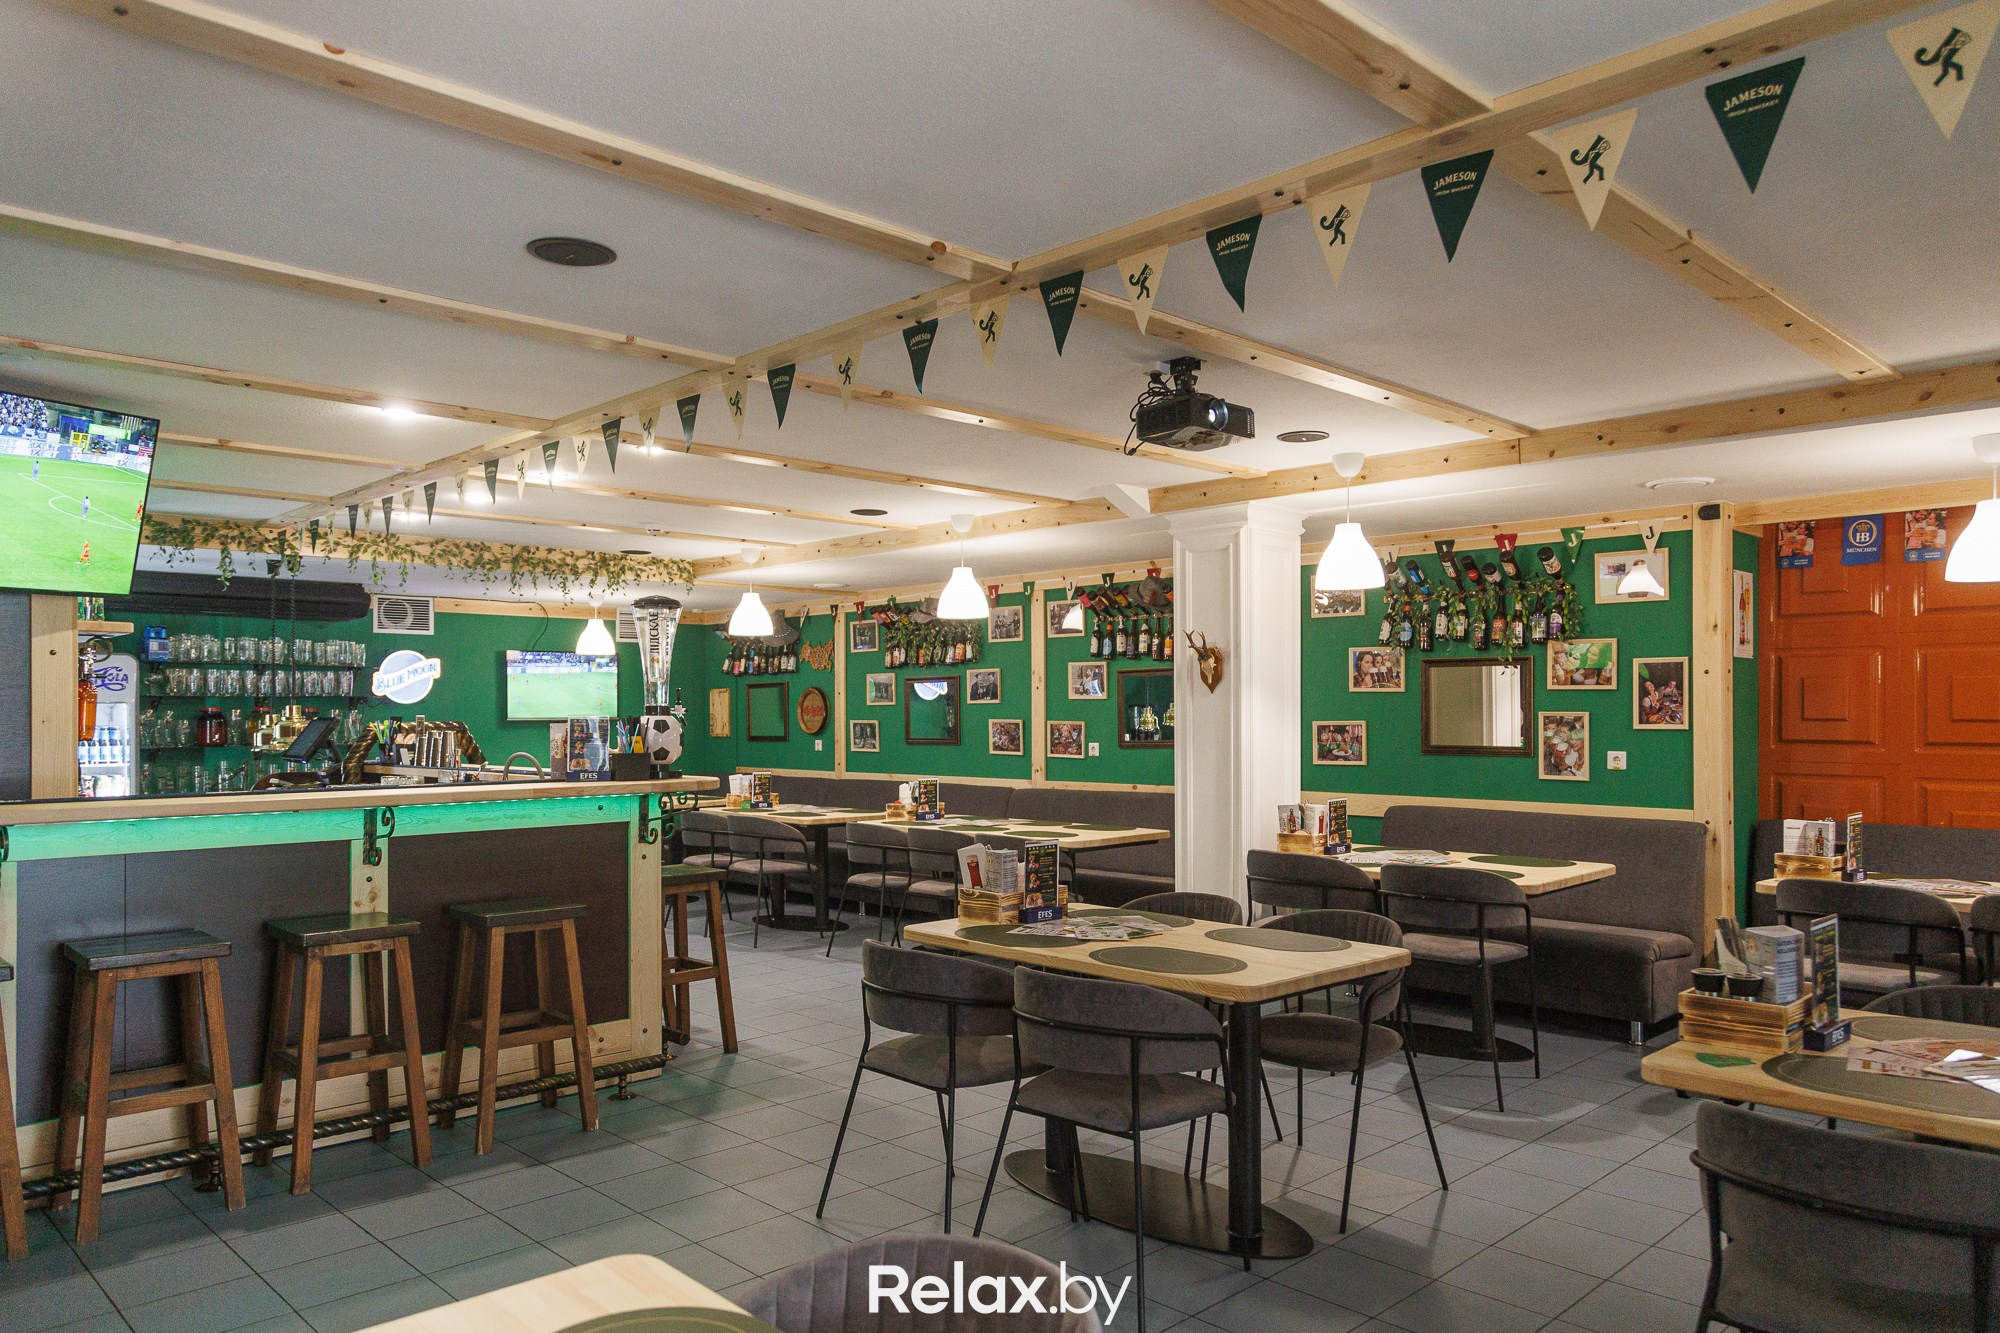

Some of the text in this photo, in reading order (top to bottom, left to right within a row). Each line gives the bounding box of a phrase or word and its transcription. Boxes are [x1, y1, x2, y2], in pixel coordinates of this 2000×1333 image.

[1723, 84, 1783, 111] JAMESON
[1433, 171, 1478, 190] JAMESON
[1216, 232, 1251, 251] JAMESON
[1049, 286, 1076, 302] JAMESON
[910, 332, 931, 346] JAMESON
[1645, 525, 1656, 540] J
[1855, 532, 1870, 543] HB
[1568, 532, 1579, 548] J
[1067, 581, 1073, 592] J
[1104, 576, 1111, 588] J
[990, 588, 996, 599] J
[1024, 585, 1031, 596] J
[375, 662, 437, 693] BLUE MOON
[580, 772, 598, 780] EFES
[1037, 909, 1053, 919] EFES
